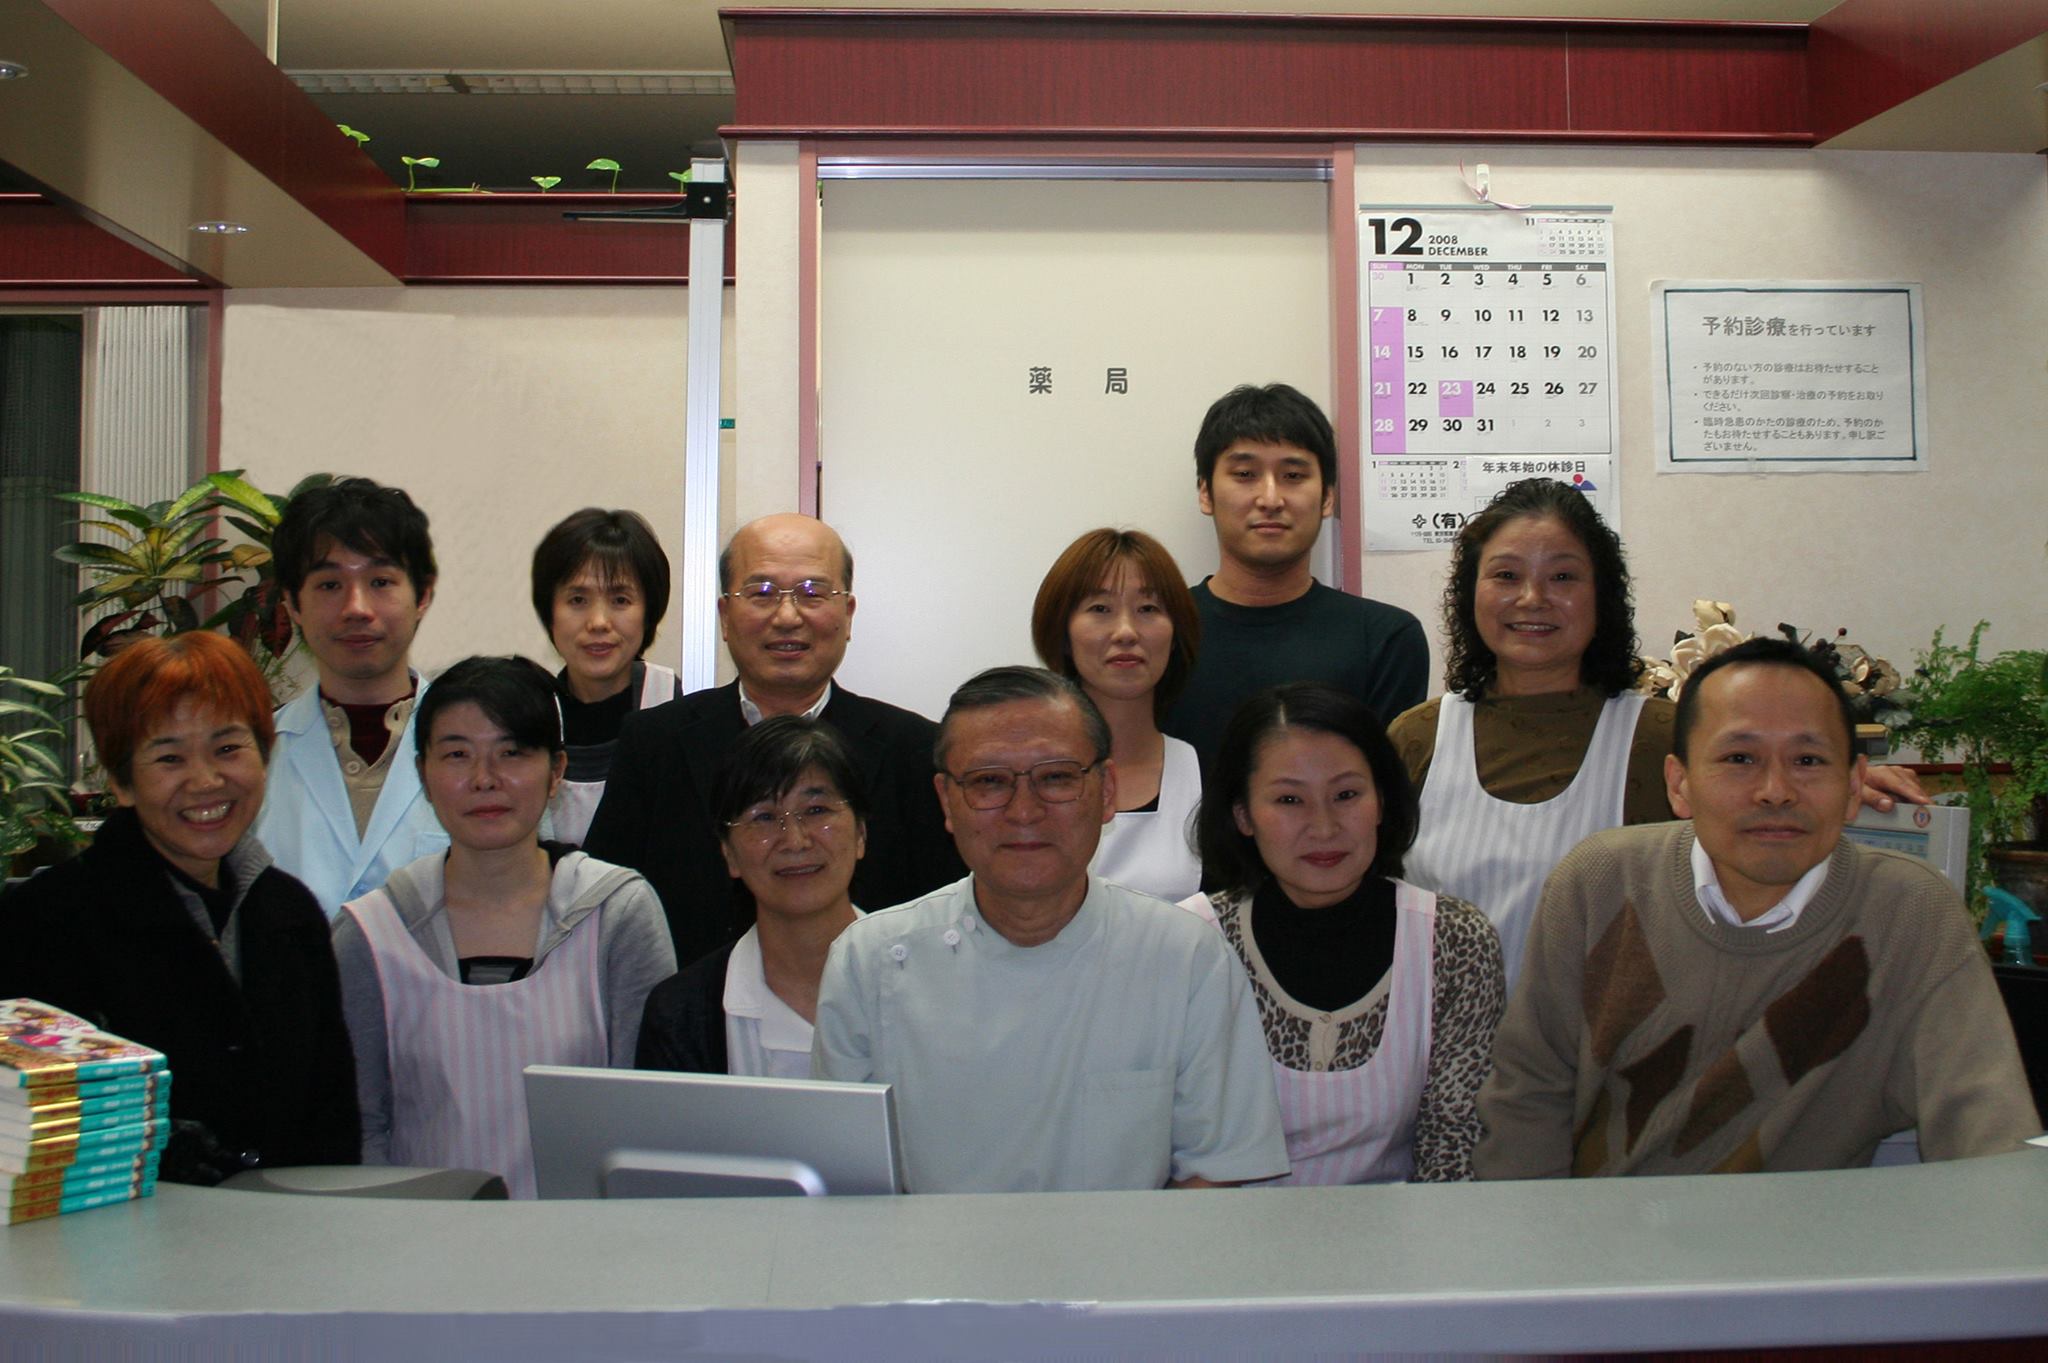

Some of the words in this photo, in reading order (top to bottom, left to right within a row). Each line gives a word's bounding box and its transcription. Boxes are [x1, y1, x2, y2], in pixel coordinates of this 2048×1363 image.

[1525, 218, 1536, 226] 11
[1368, 217, 1423, 255] 12
[1428, 235, 1458, 245] 2008
[1428, 247, 1488, 256] DECEMBER
[1408, 273, 1414, 285] 1
[1441, 273, 1450, 285] 2
[1475, 273, 1484, 285] 3
[1508, 273, 1518, 285] 4
[1543, 273, 1551, 285] 5
[1576, 273, 1586, 285] 6
[1374, 309, 1384, 322] 7
[1408, 309, 1417, 322] 8
[1441, 309, 1450, 322] 9
[1475, 309, 1492, 322] 10
[1509, 309, 1523, 322] 11
[1543, 309, 1559, 322] 12
[1578, 309, 1593, 322] 13
[1701, 316, 1876, 337] 予約診療を行っています
[1374, 346, 1391, 359] 14
[1408, 346, 1423, 359] 15
[1442, 346, 1458, 359] 16
[1476, 346, 1492, 359] 17
[1510, 346, 1526, 359] 18
[1544, 346, 1560, 359] 19
[1578, 346, 1597, 359] 20
[1029, 366, 1128, 394] 薬局
[1374, 383, 1391, 395] 21
[1408, 383, 1427, 395] 22
[1442, 383, 1461, 395] 23
[1476, 383, 1495, 395] 24
[1511, 383, 1529, 395] 25
[1544, 383, 1564, 395] 26
[1578, 383, 1597, 395] 27
[1375, 419, 1394, 432] 28
[1409, 419, 1428, 432] 29
[1443, 419, 1462, 432] 30
[1477, 419, 1494, 432] 31
[1482, 461, 1585, 473] 年末年始の休診日
